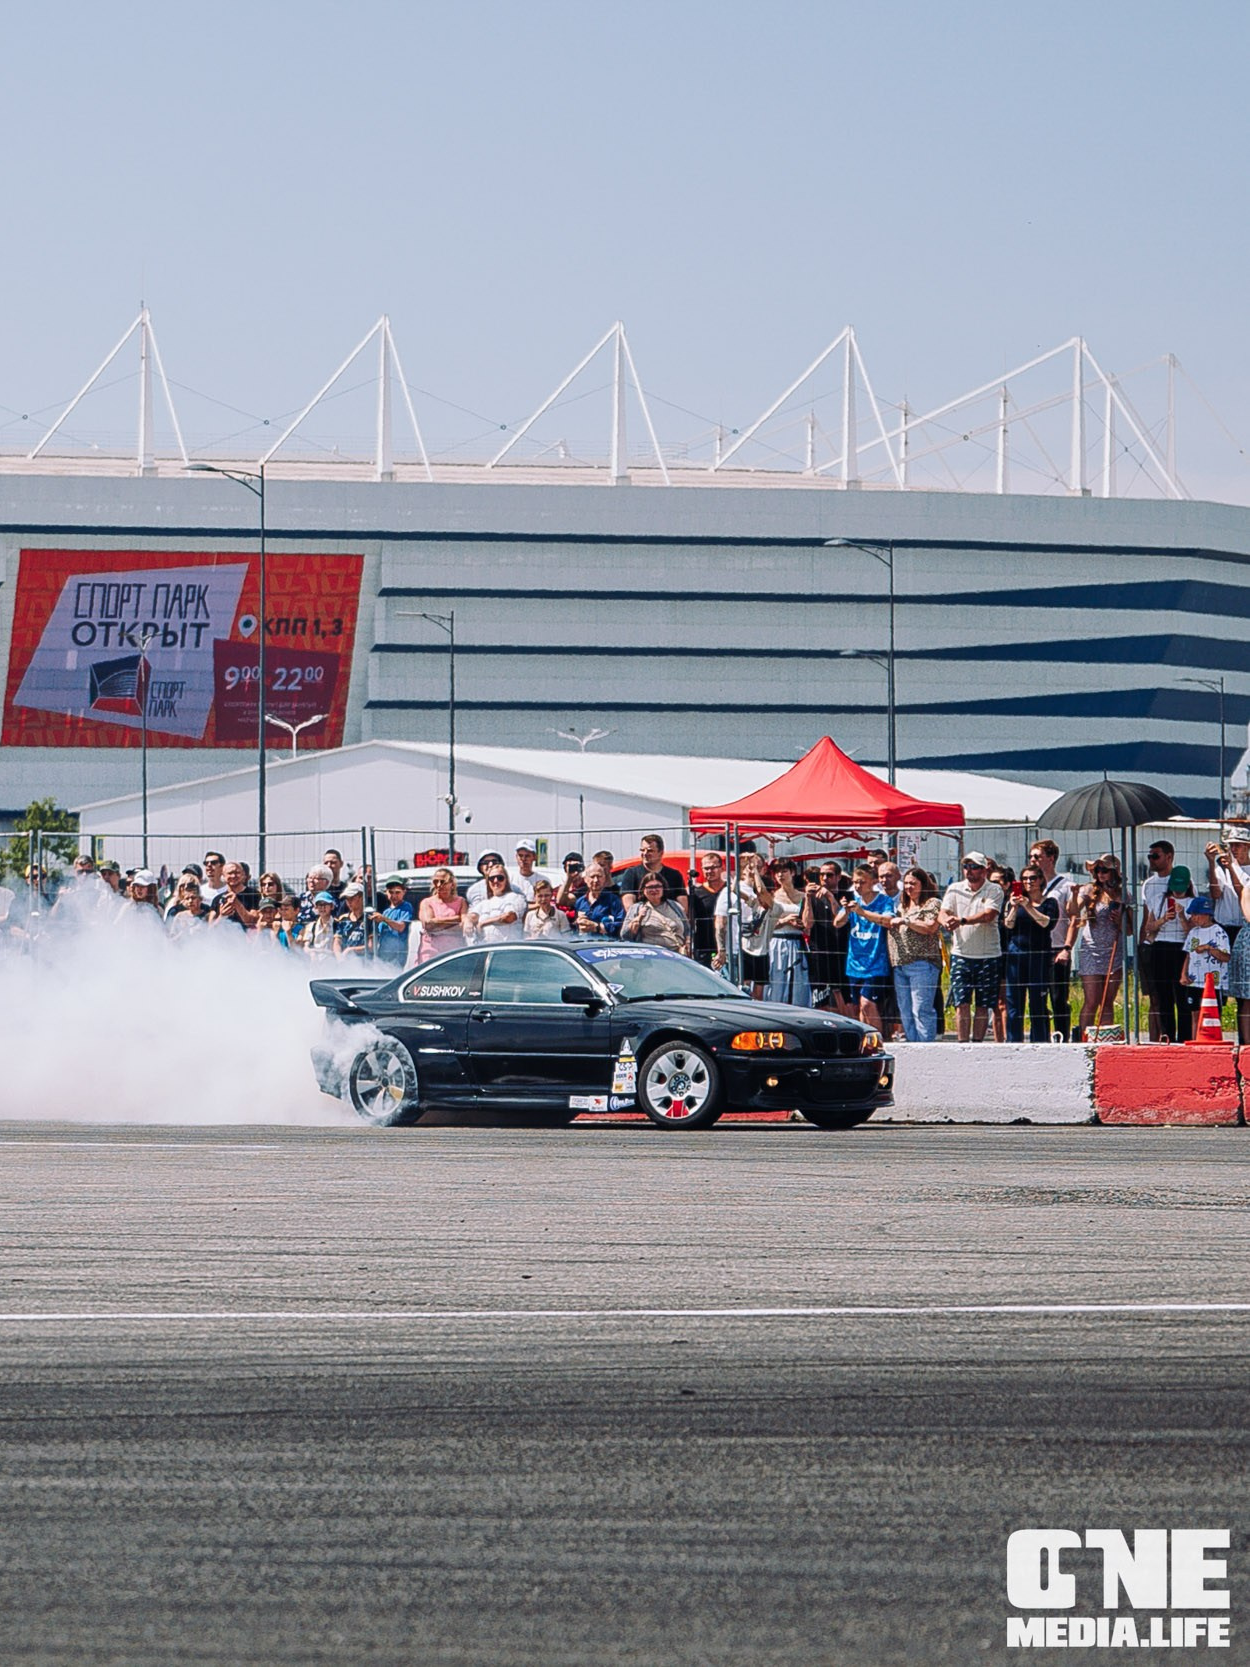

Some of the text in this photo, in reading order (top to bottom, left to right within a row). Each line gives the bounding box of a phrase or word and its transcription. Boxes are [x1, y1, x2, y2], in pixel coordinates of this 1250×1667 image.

[74, 583, 210, 619] СПОРТ ПАРК
[71, 621, 210, 648] ОТКРЫТ
